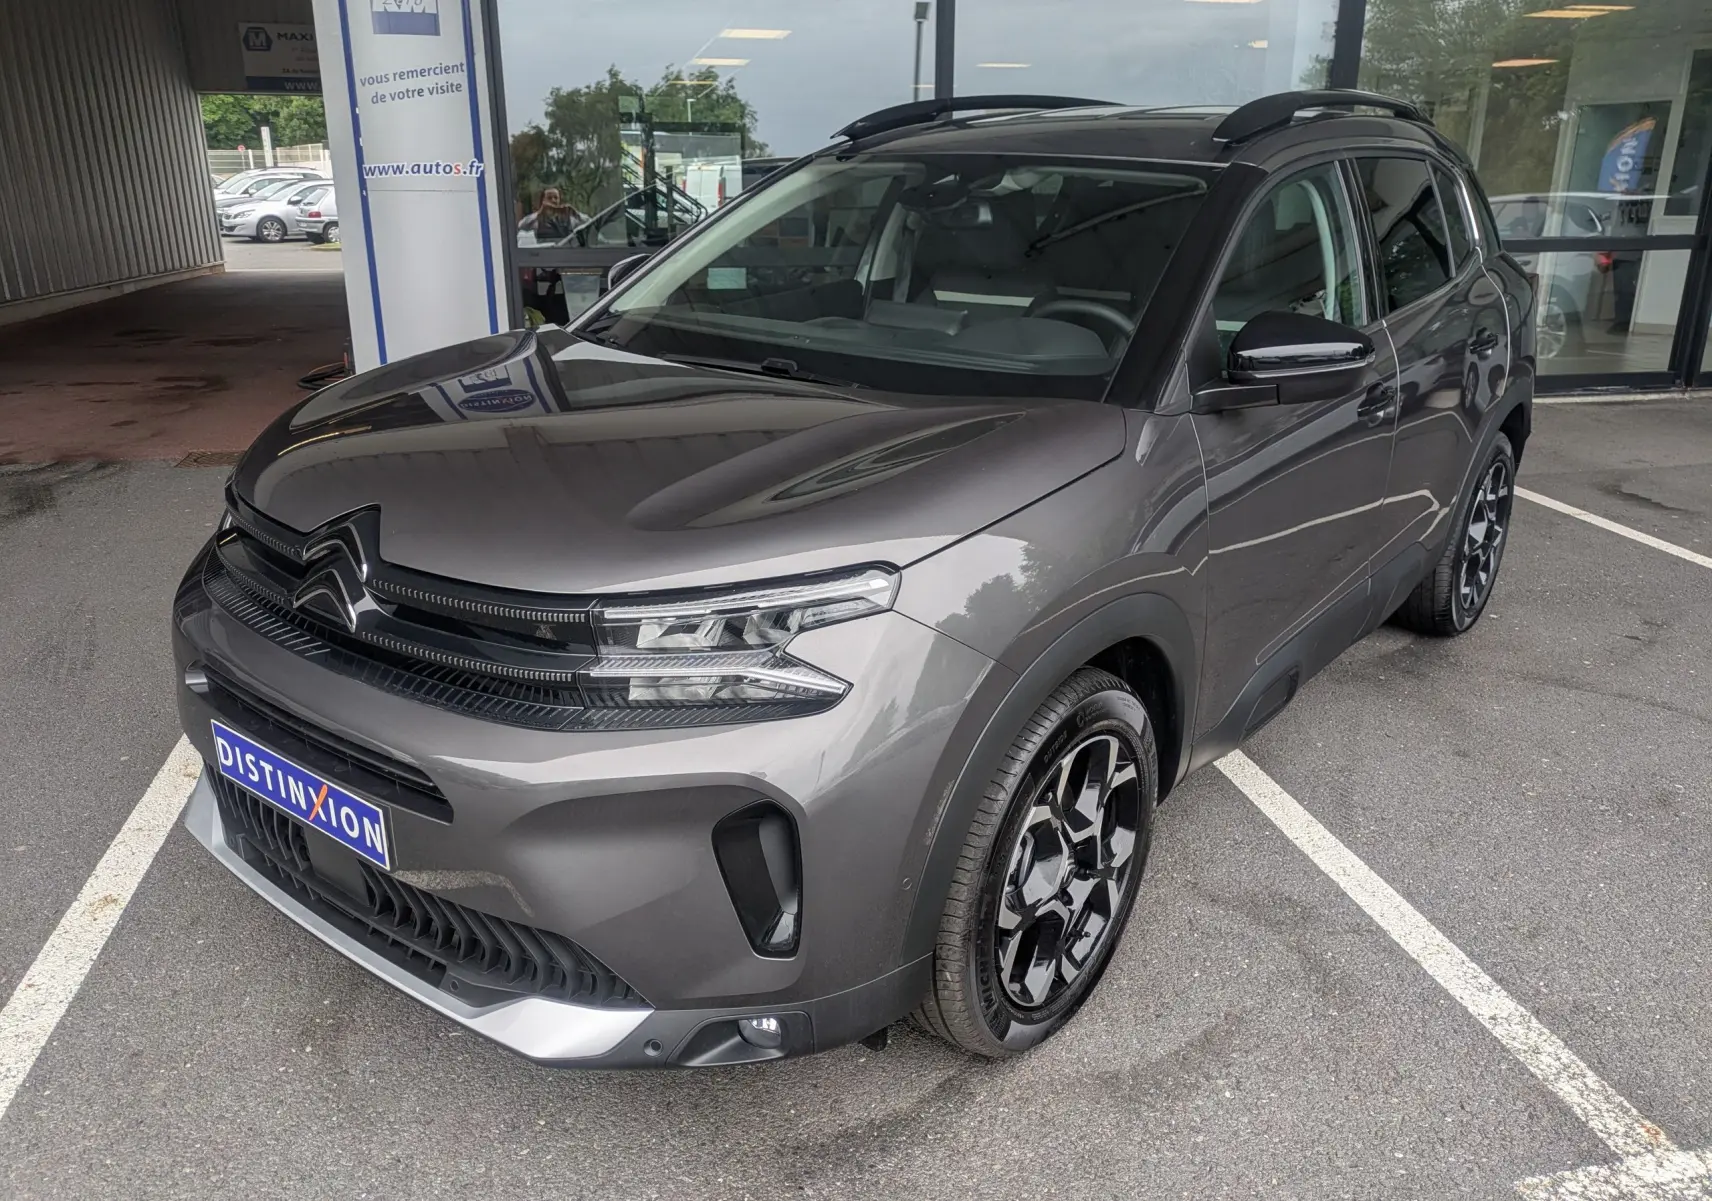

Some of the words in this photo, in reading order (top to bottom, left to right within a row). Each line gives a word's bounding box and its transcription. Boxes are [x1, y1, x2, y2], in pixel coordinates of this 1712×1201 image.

[360, 73, 390, 87] vous
[393, 62, 465, 82] remercient
[371, 92, 387, 104] de
[389, 87, 424, 101] votre
[427, 81, 463, 96] visite
[364, 160, 483, 177] www.autos.fr
[216, 736, 384, 855] DISTINXION
